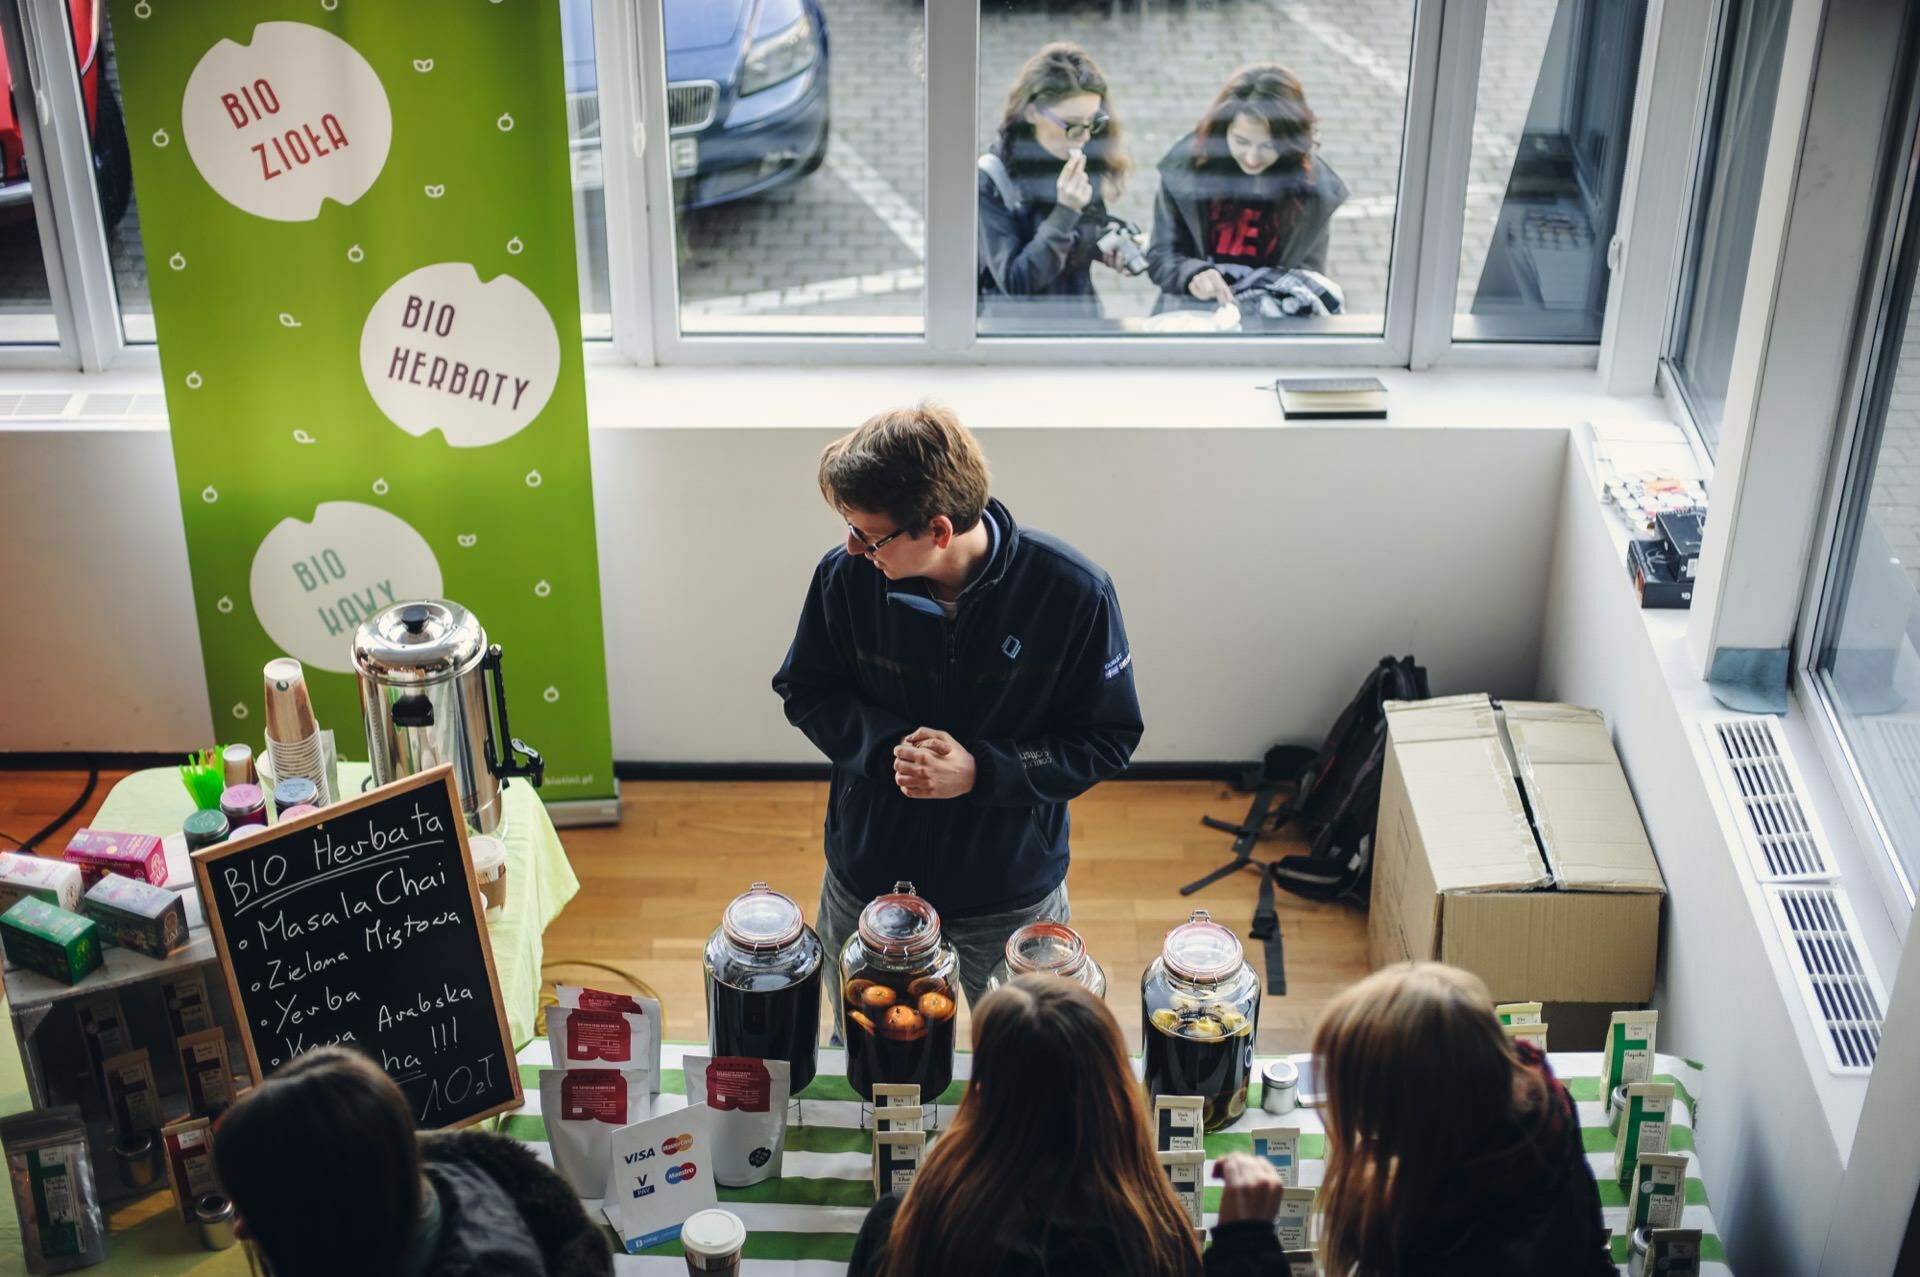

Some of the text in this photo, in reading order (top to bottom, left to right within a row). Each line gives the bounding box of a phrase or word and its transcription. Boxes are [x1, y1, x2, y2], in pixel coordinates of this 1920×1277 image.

[220, 77, 281, 130] BIO
[251, 112, 349, 181] ZIOŁA
[401, 295, 455, 338] BIO
[388, 346, 531, 412] HERBATY
[292, 548, 347, 593] BIO
[224, 802, 444, 907] BIO Herbata
[257, 862, 446, 950] Masala Chai
[274, 985, 361, 1034] Yerba
[378, 983, 474, 1032] Arabska
[624, 1147, 656, 1164] VISA
[668, 1167, 695, 1182] Maestro
